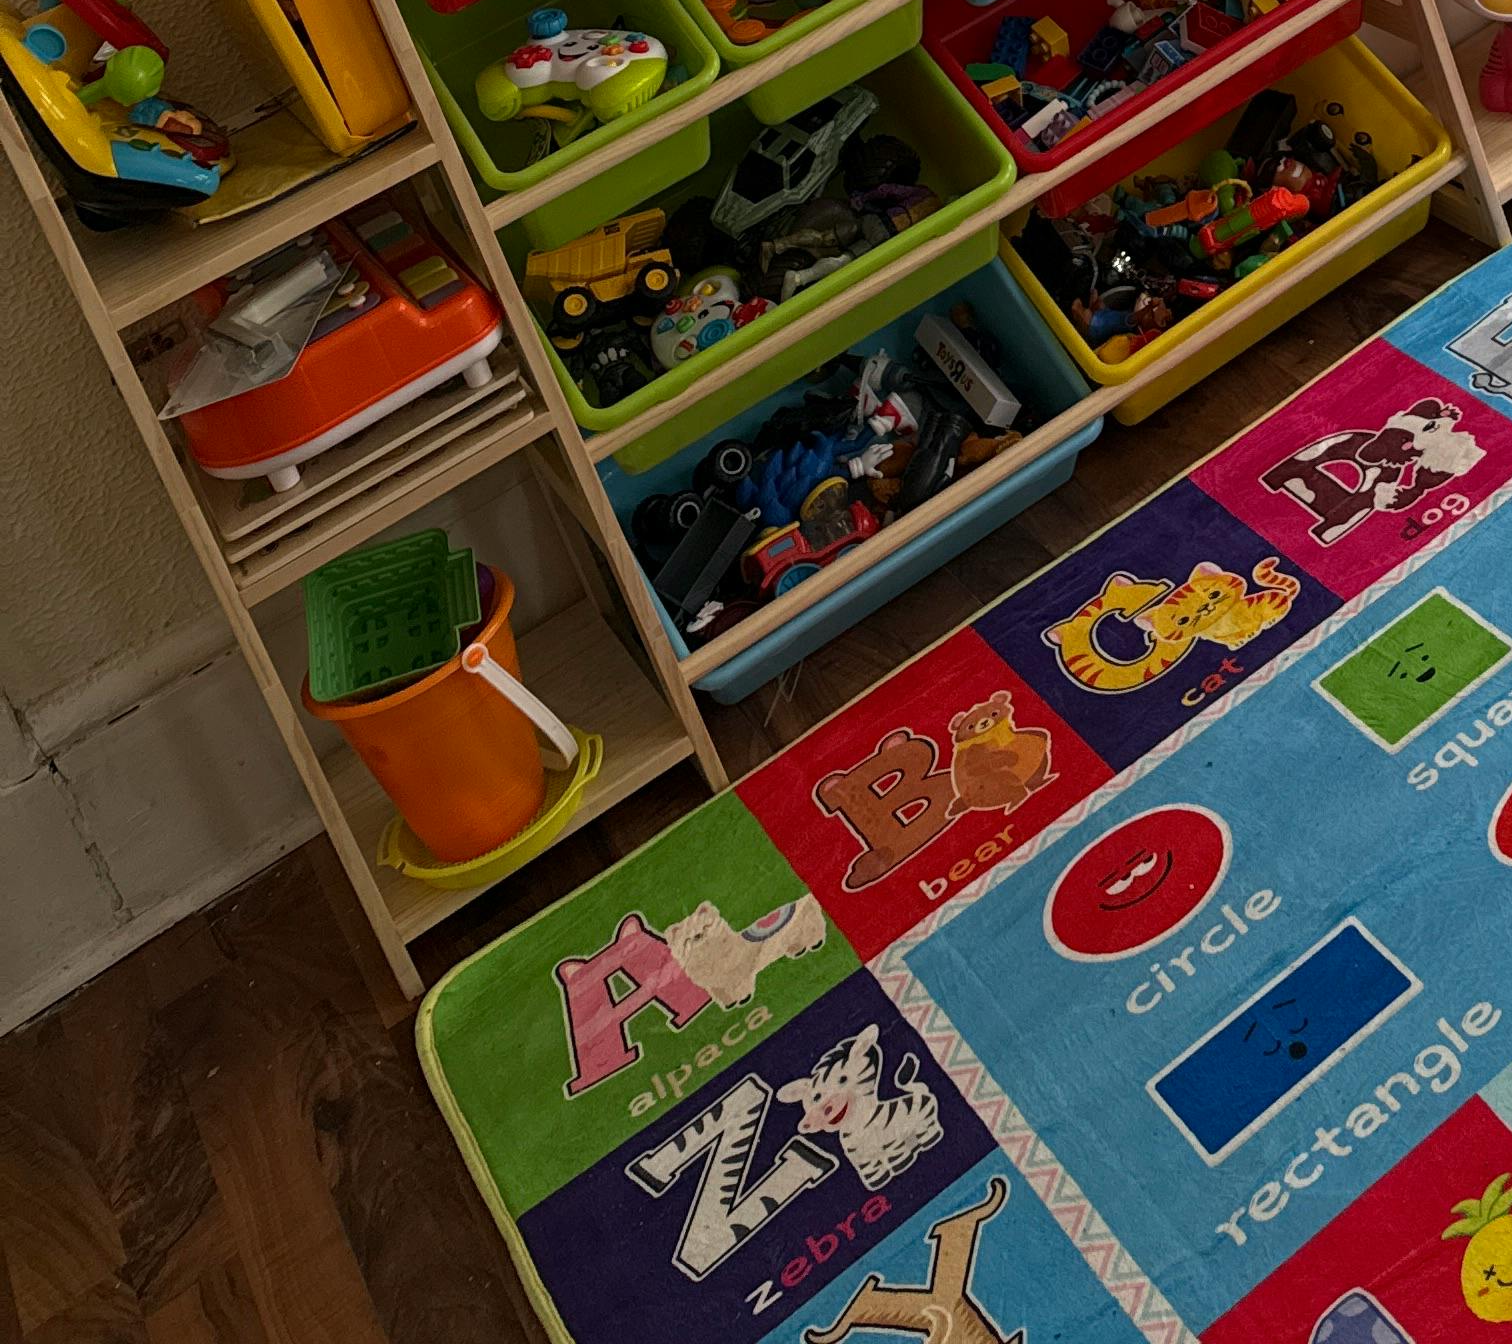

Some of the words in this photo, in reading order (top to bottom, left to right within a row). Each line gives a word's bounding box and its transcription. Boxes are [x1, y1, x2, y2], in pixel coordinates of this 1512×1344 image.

[1262, 425, 1390, 550] D
[1399, 491, 1471, 545] dog
[1046, 571, 1203, 696] C
[1179, 655, 1246, 709] cat
[812, 727, 955, 893] B
[916, 822, 1018, 902] bear
[552, 911, 714, 1101] A
[1124, 887, 1284, 1016] circle
[626, 1002, 775, 1119] alpaca
[625, 1072, 841, 1282] Z
[1213, 999, 1503, 1248] rectangle
[744, 1192, 893, 1316] zebra
